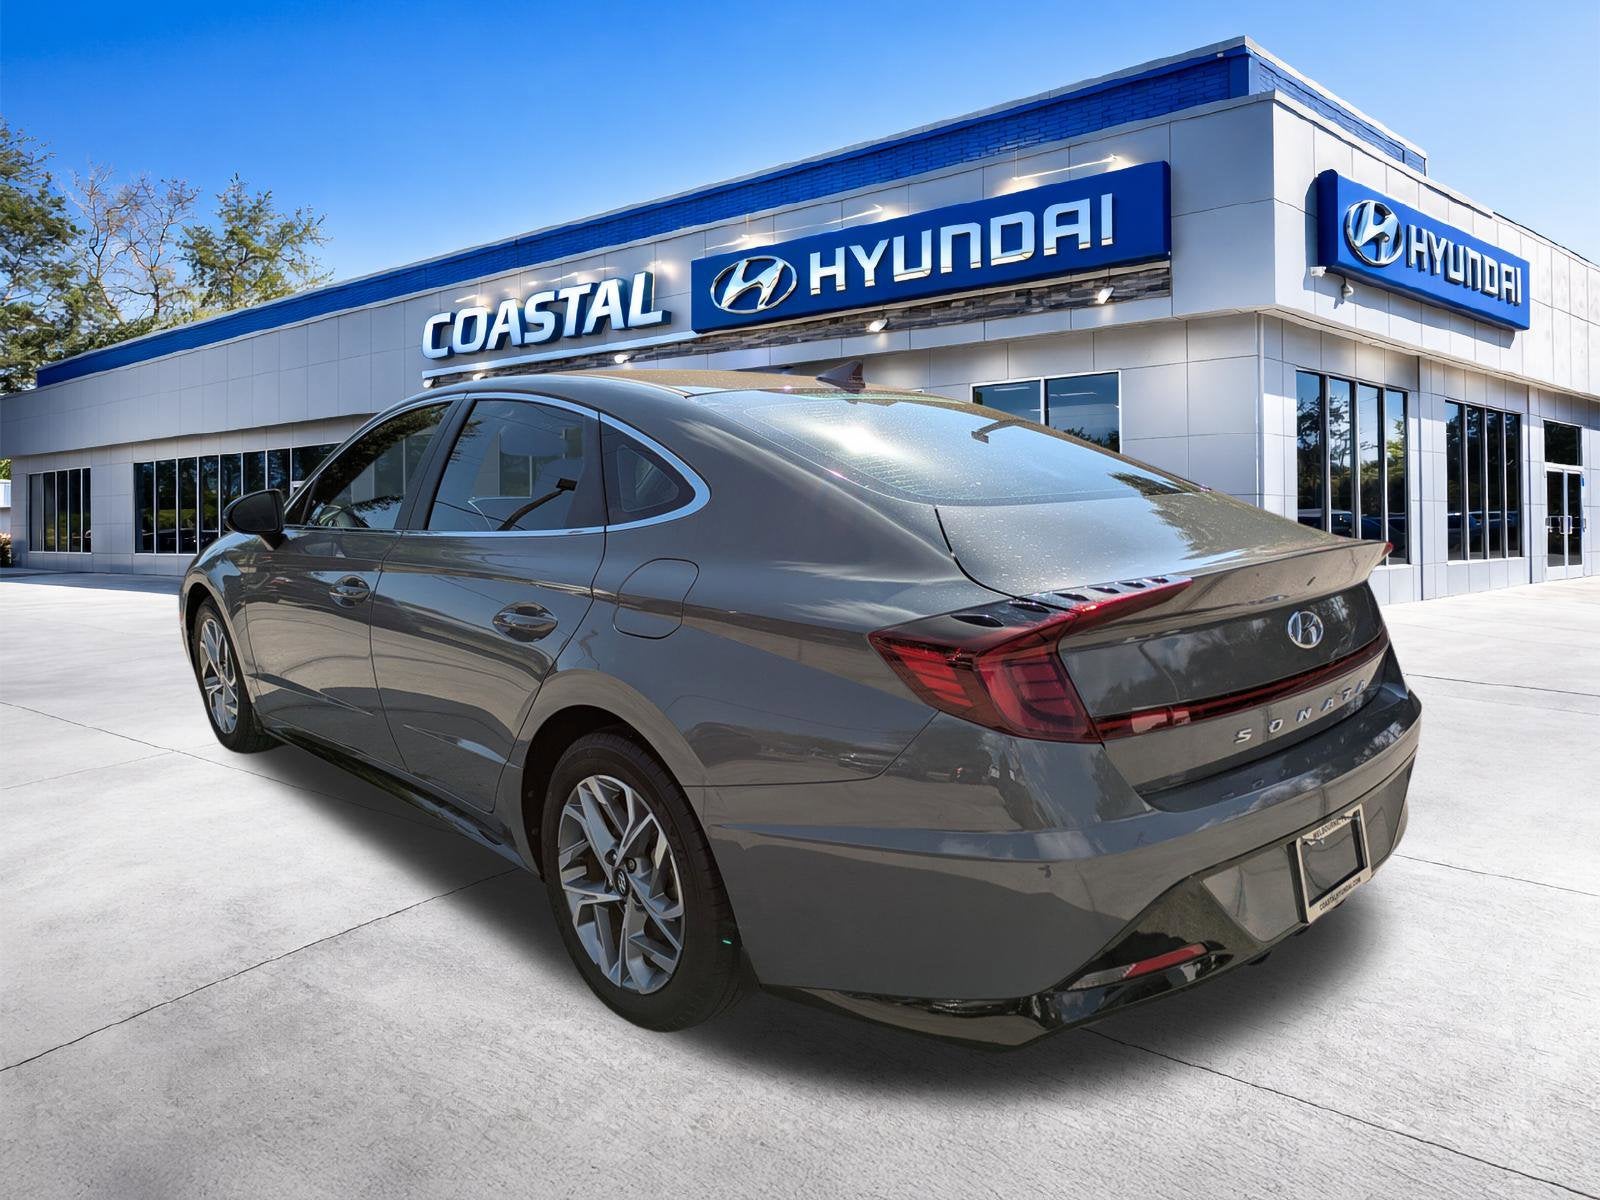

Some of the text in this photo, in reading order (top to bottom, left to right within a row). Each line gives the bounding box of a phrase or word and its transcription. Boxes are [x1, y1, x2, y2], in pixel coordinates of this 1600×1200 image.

[809, 192, 1114, 296] HYUNDAI
[1407, 223, 1522, 306] HYUNDAI
[422, 271, 667, 359] COASTAL
[1234, 679, 1367, 744] SONATA
